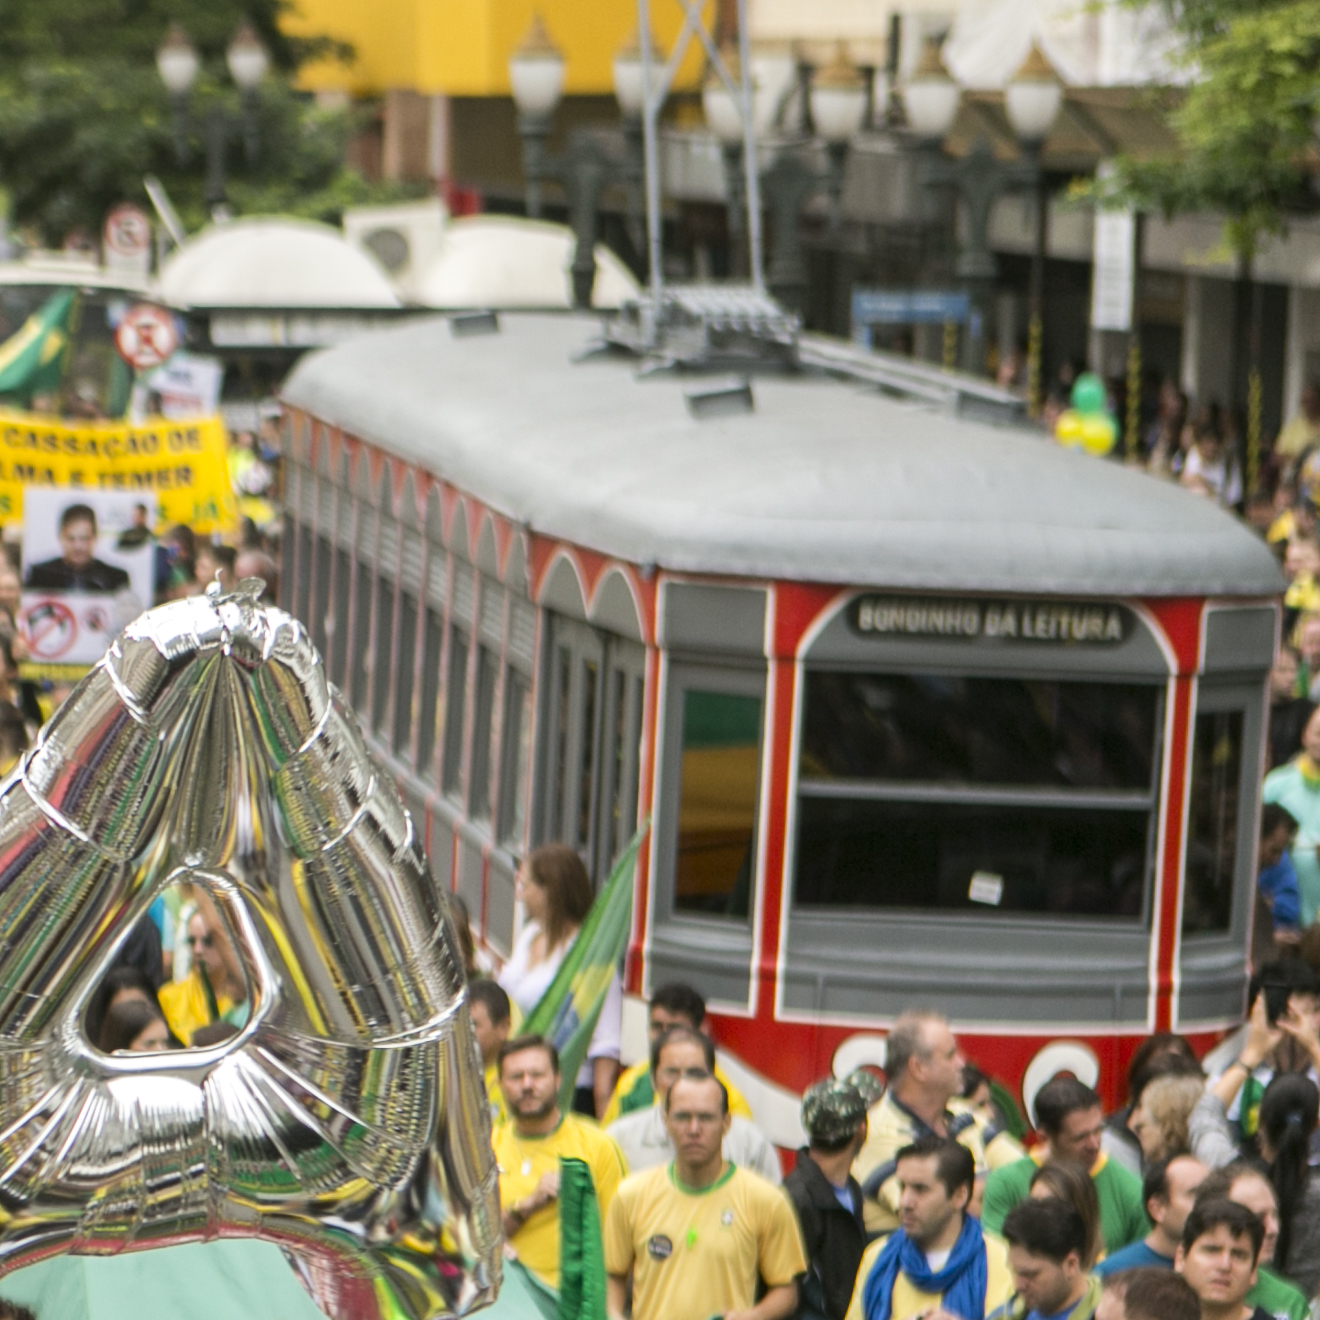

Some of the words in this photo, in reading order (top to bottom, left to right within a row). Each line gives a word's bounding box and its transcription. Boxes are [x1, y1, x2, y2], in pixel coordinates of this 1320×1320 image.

[858, 601, 980, 636] BONDINHO
[984, 604, 1016, 637] DA
[1021, 606, 1123, 640] LEITURA
